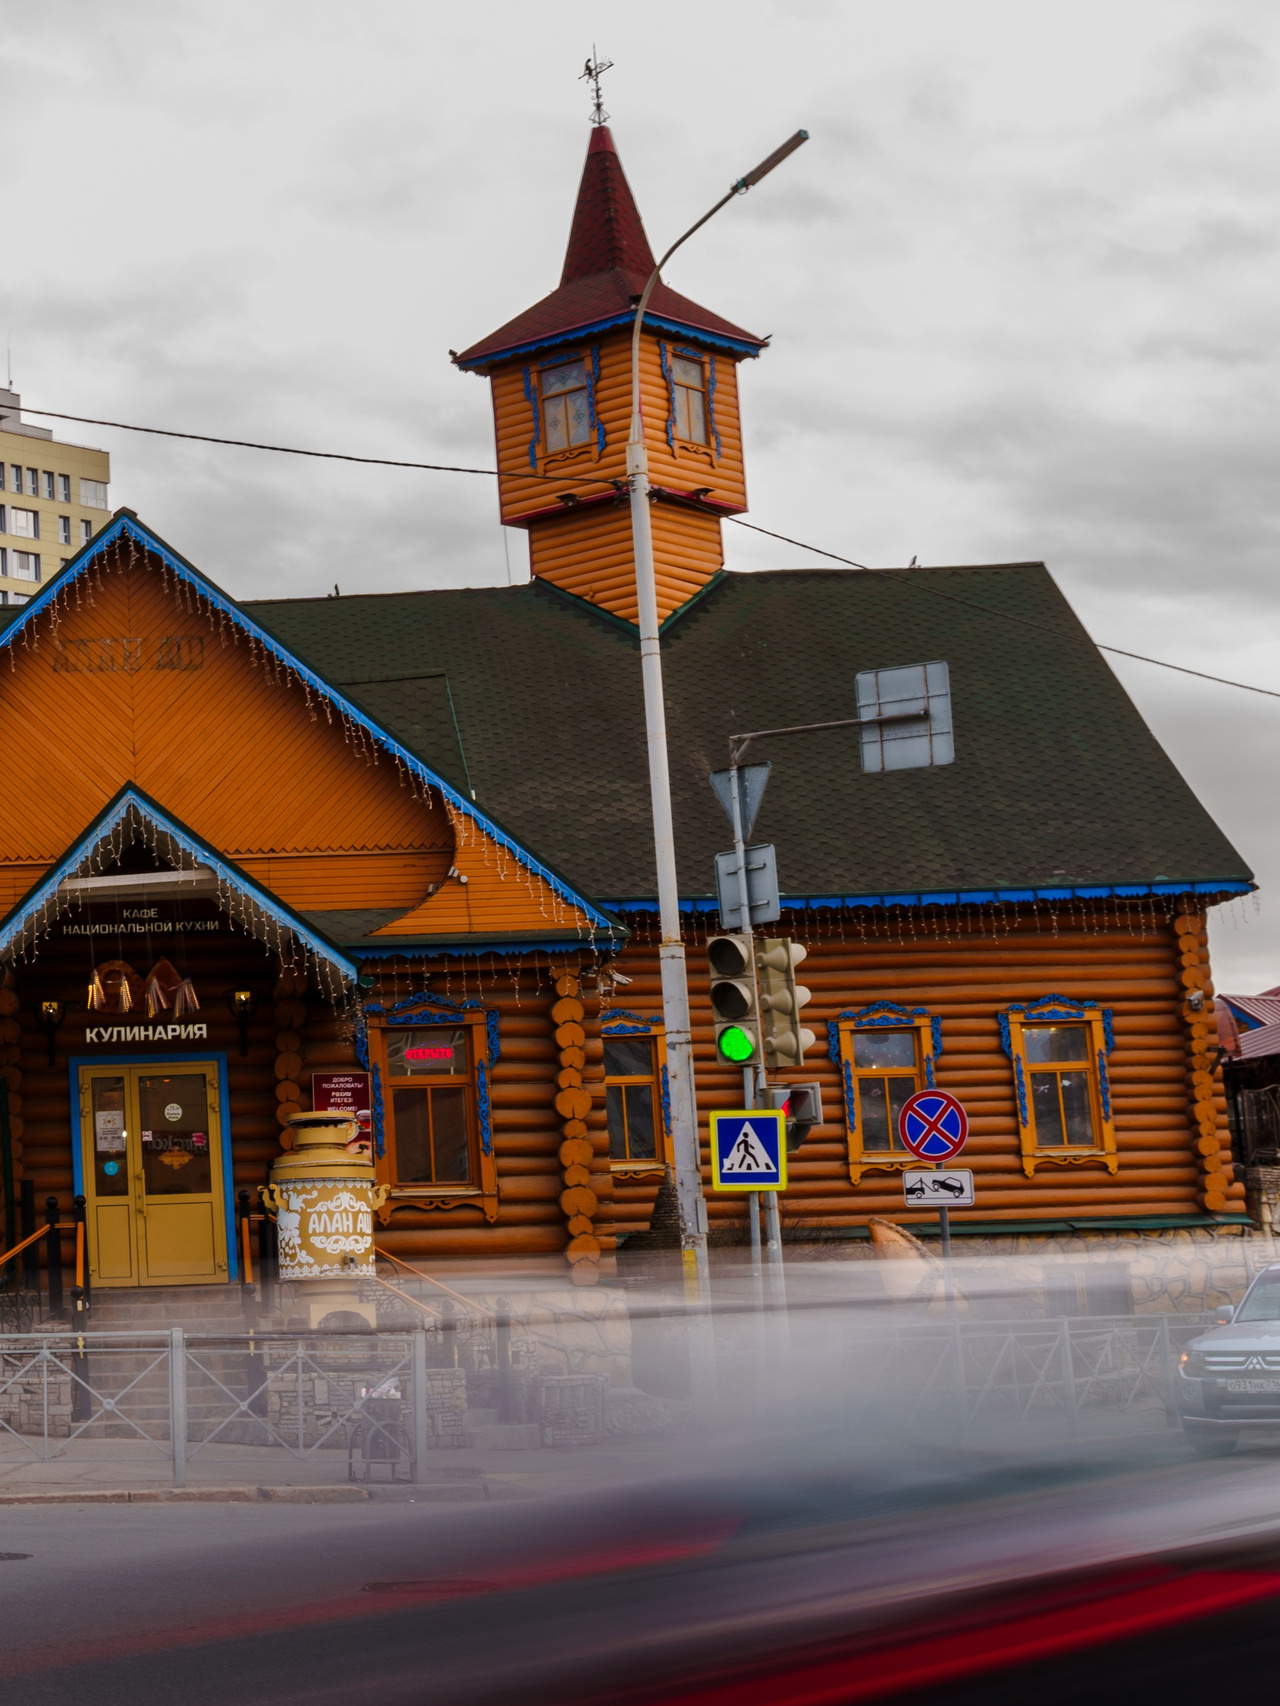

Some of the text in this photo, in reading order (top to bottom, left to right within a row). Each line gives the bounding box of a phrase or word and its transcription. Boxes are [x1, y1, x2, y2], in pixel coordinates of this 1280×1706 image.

[123, 908, 158, 919] КАФЕ
[63, 920, 219, 936] НАЦИОНАЛЬНОЙ КУХНИ
[86, 1023, 207, 1043] КУЛИНАРИЯ
[405, 1047, 453, 1060] ОТКРЫТО
[308, 1212, 372, 1234] АЛАН АШ
